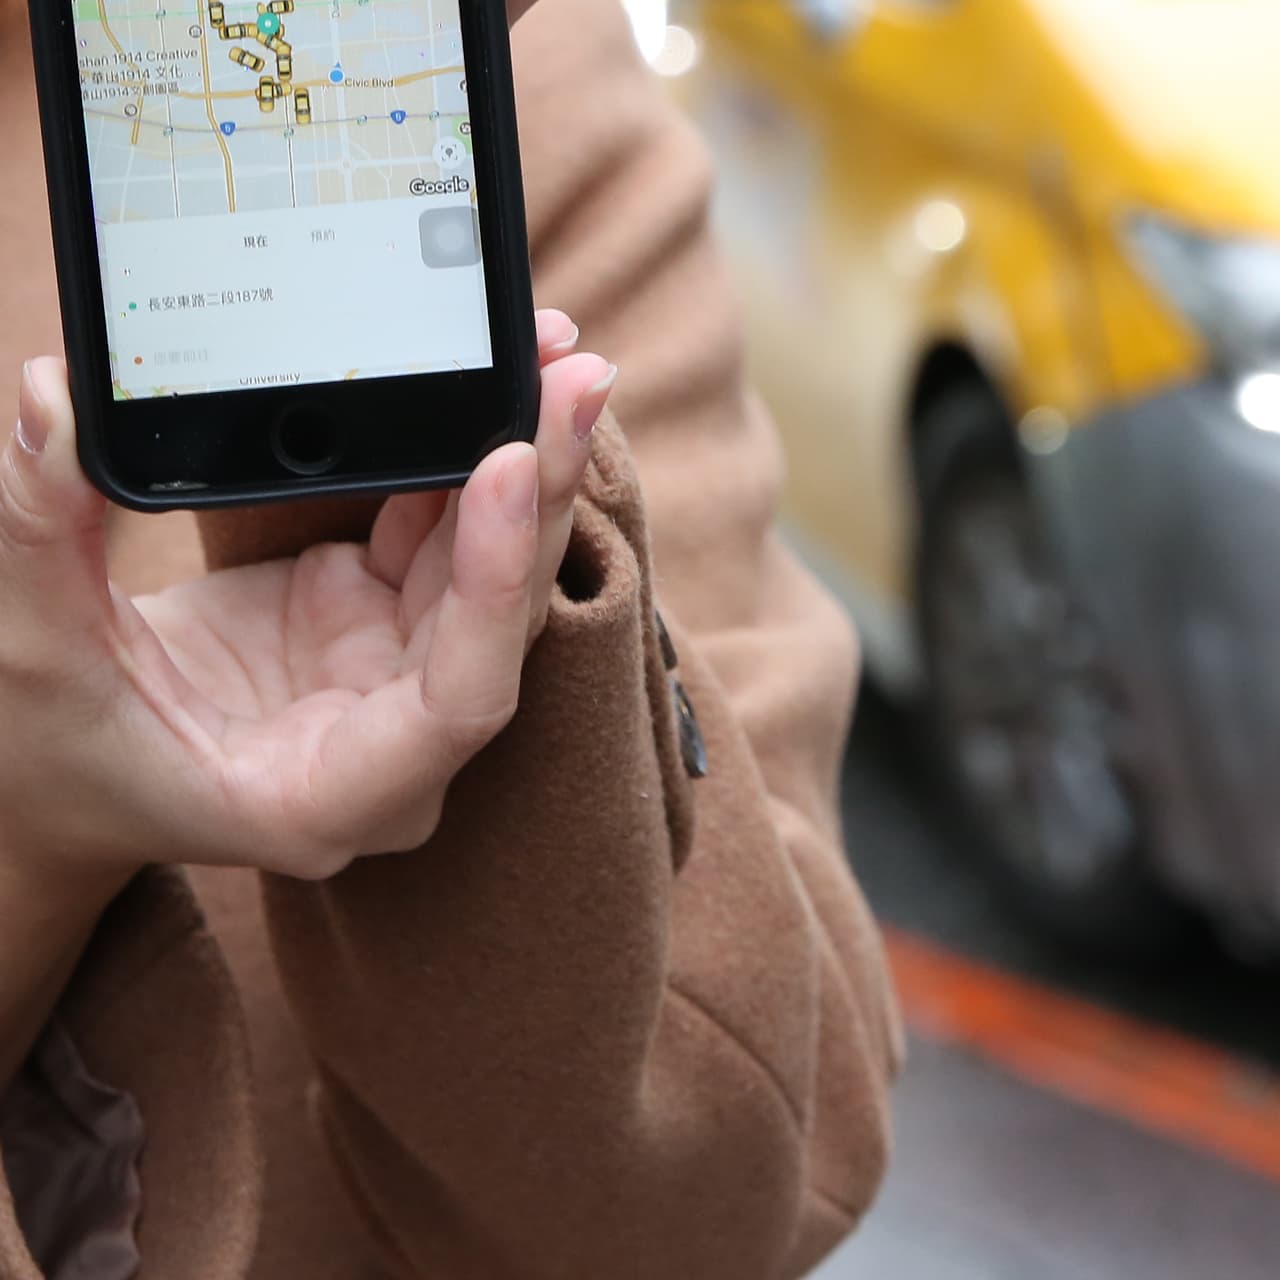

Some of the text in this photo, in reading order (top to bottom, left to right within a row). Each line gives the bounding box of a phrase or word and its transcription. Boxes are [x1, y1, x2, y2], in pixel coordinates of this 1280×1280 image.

[114, 52, 142, 65] 1914
[146, 48, 198, 61] Creative
[345, 77, 394, 89] Civic Blvd
[409, 176, 469, 196] Google
[243, 234, 269, 249] 現在
[149, 287, 274, 312] 長安東路二段187號
